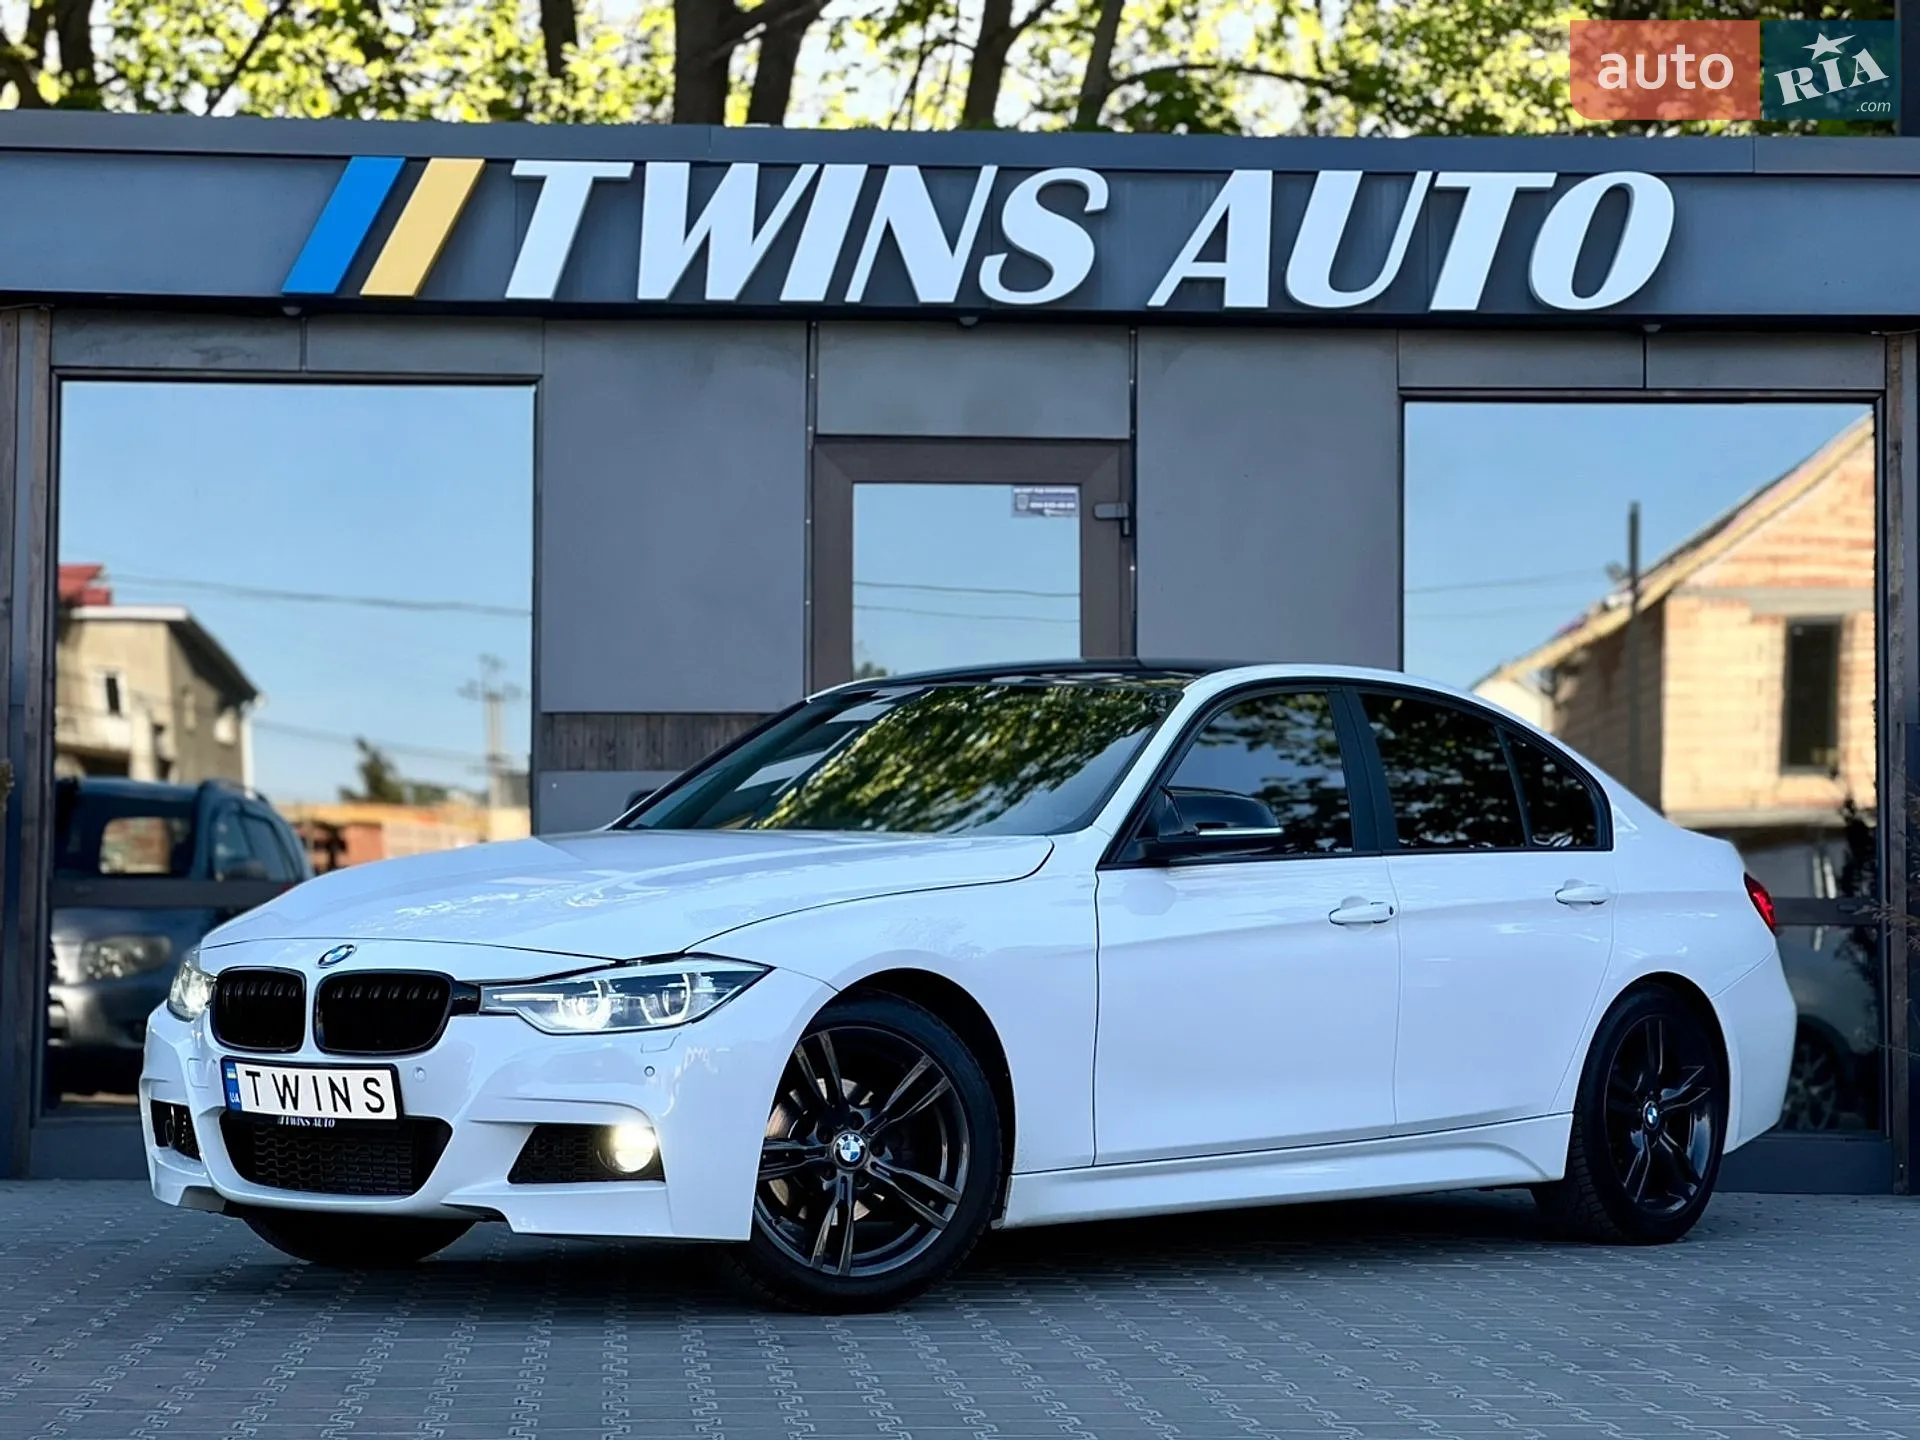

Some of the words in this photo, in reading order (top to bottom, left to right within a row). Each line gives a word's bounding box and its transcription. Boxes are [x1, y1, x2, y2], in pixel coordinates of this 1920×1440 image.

[505, 159, 1110, 304] TWINS
[1147, 169, 1675, 310] AUTO
[230, 1093, 241, 1103] UA
[245, 1070, 385, 1113] TWINS
